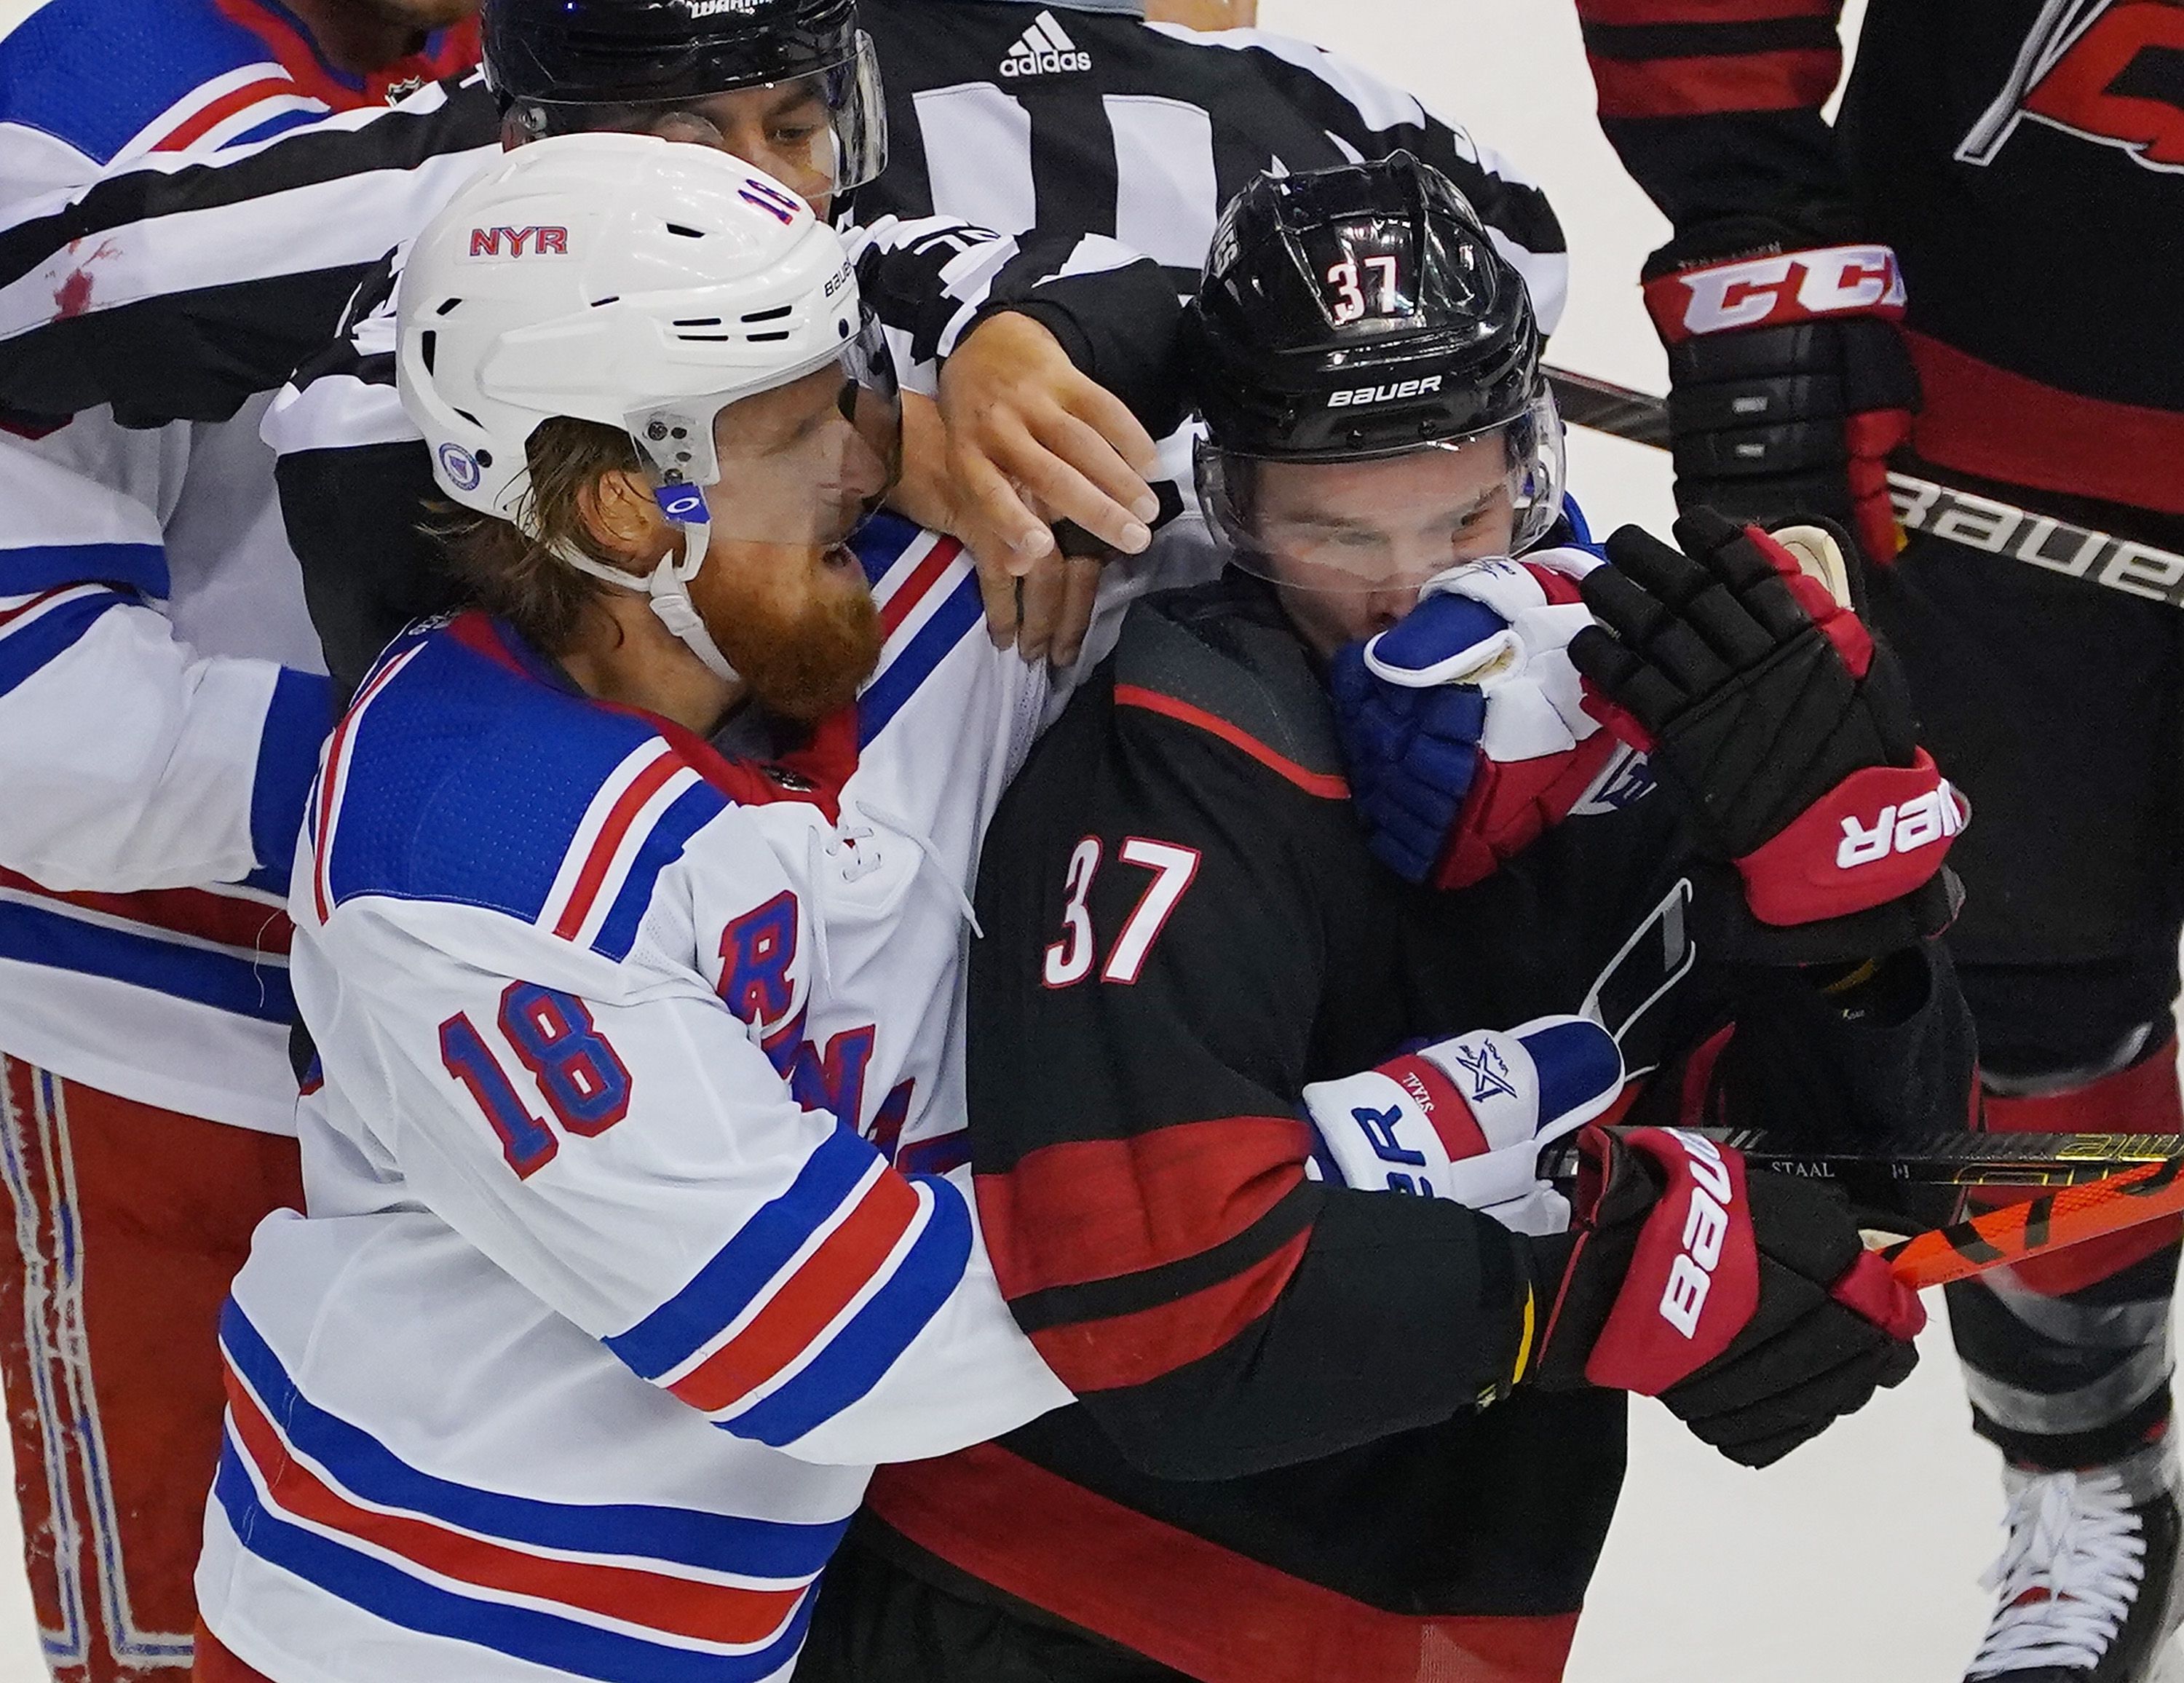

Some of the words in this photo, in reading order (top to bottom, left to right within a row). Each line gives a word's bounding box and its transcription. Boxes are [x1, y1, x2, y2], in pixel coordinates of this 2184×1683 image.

[1000, 49, 1092, 78] adidas
[737, 178, 802, 226] 18
[470, 226, 569, 259] NYR
[1326, 255, 1397, 326] 37
[1326, 373, 1443, 408] BAUER
[1886, 471, 2184, 609] BAUE
[1041, 834, 1203, 989] 37
[438, 978, 633, 1181] 18
[1402, 1071, 1436, 1114] STAAL
[1771, 1160, 1835, 1178] STAAL
